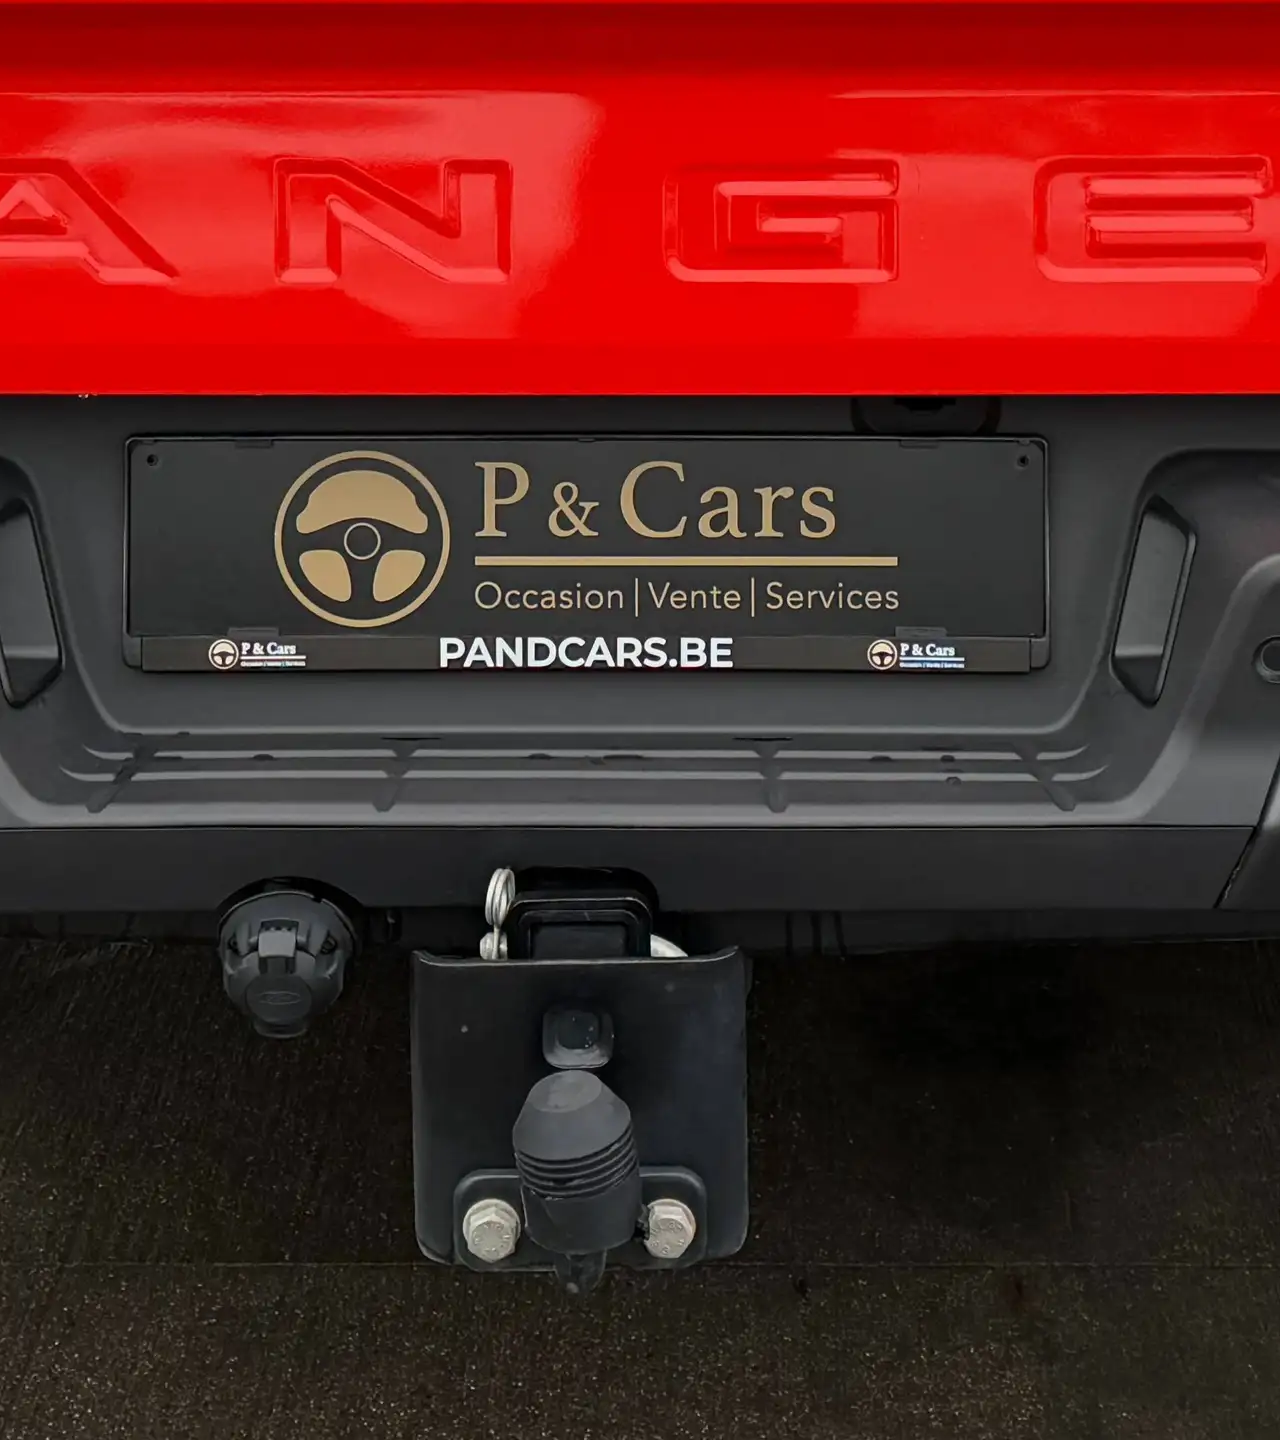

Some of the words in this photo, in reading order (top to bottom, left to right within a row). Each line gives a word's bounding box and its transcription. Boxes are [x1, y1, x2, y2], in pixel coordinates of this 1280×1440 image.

[475, 461, 530, 538] P
[548, 481, 600, 538] &
[620, 460, 837, 539] Cars
[474, 580, 624, 610] Occasion
[648, 581, 741, 610] Vente
[765, 580, 899, 610] Services
[241, 642, 251, 655] P
[253, 642, 265, 655] &
[267, 642, 297, 655] Cars
[439, 636, 734, 668] PANDCARS.BE
[900, 643, 910, 656] P
[912, 644, 924, 656] &
[926, 643, 956, 656] Cars
